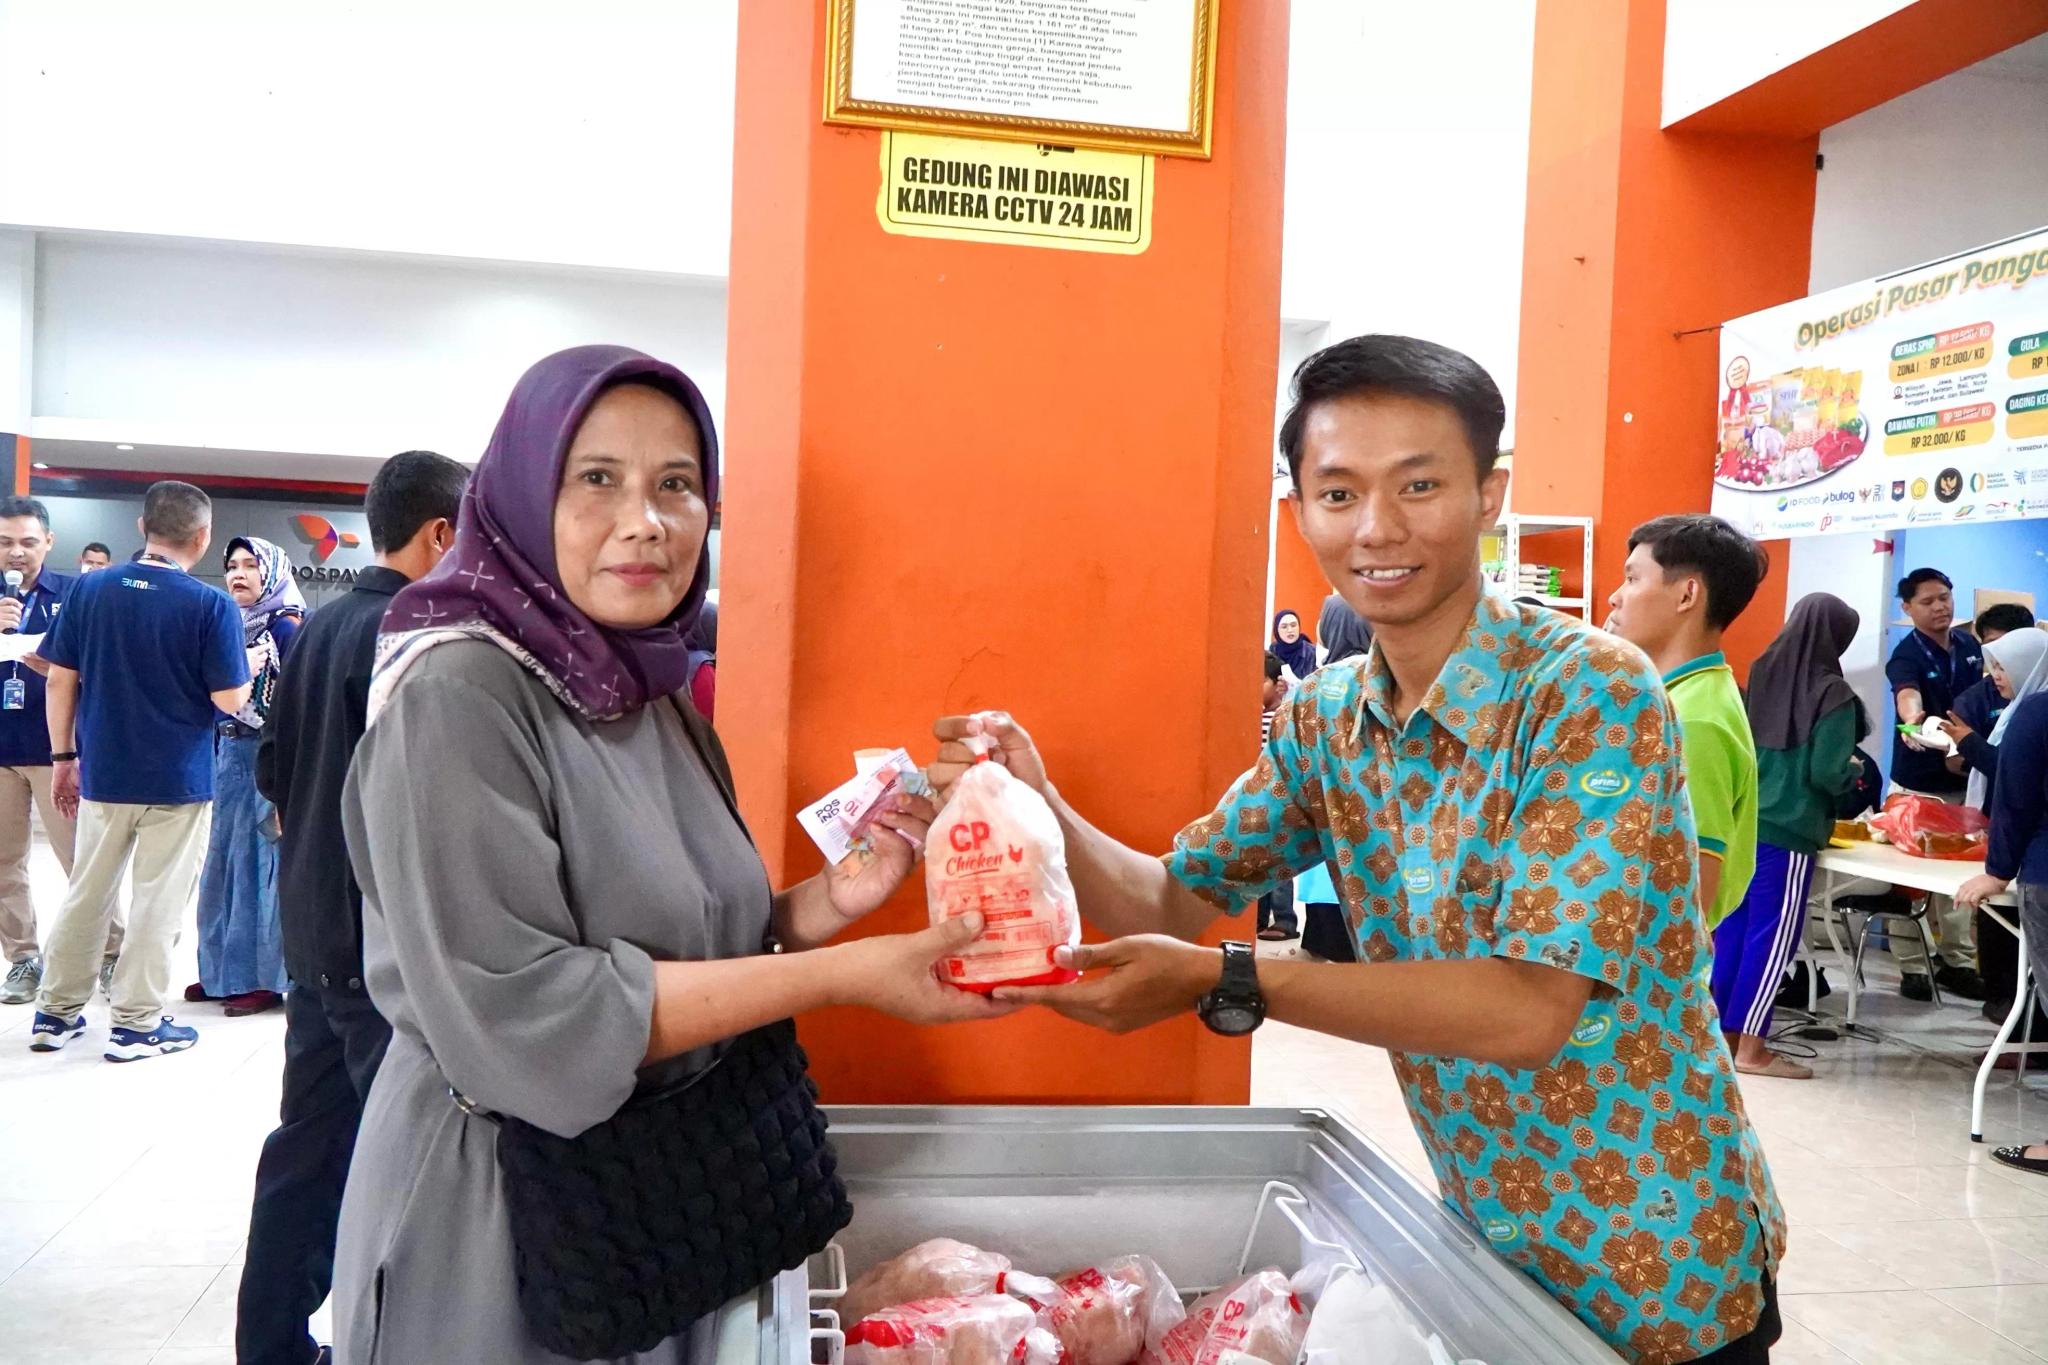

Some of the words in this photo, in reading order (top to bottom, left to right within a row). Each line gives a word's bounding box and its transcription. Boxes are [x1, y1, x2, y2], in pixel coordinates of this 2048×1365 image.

[903, 156, 992, 190] GEDUNG
[998, 166, 1029, 193] INI
[1034, 169, 1130, 202] DIAWASI
[897, 187, 989, 219] KAMERA
[994, 196, 1054, 225] CCTV
[1058, 201, 1085, 228] 24
[1090, 205, 1133, 232] JAM
[1796, 289, 1884, 348] Operasi
[1886, 271, 1960, 314] Pasar
[1895, 341, 1918, 357] BERAS
[2020, 337, 2040, 352] GULA
[1896, 363, 1916, 377] ZONA
[1930, 357, 1940, 369] RP
[1942, 349, 1973, 367] 12.000/
[1974, 347, 1985, 359] KG
[2031, 356, 2043, 370] RP
[2009, 394, 2036, 411] DAGING
[1887, 418, 1916, 433] BAWANG
[1916, 413, 1937, 428] PUTIH
[1911, 436, 1921, 449] RP
[1922, 431, 1953, 447] 32.000/
[1955, 429, 1966, 442] KG
[1829, 490, 1855, 503] bulog
[1589, 775, 1621, 790] prima
[815, 798, 841, 819] POS
[820, 808, 841, 824] IND
[949, 821, 990, 853] CP
[946, 852, 1004, 877] Chicken
[1575, 1021, 1605, 1041] prima
[1223, 1299, 1245, 1322] CP
